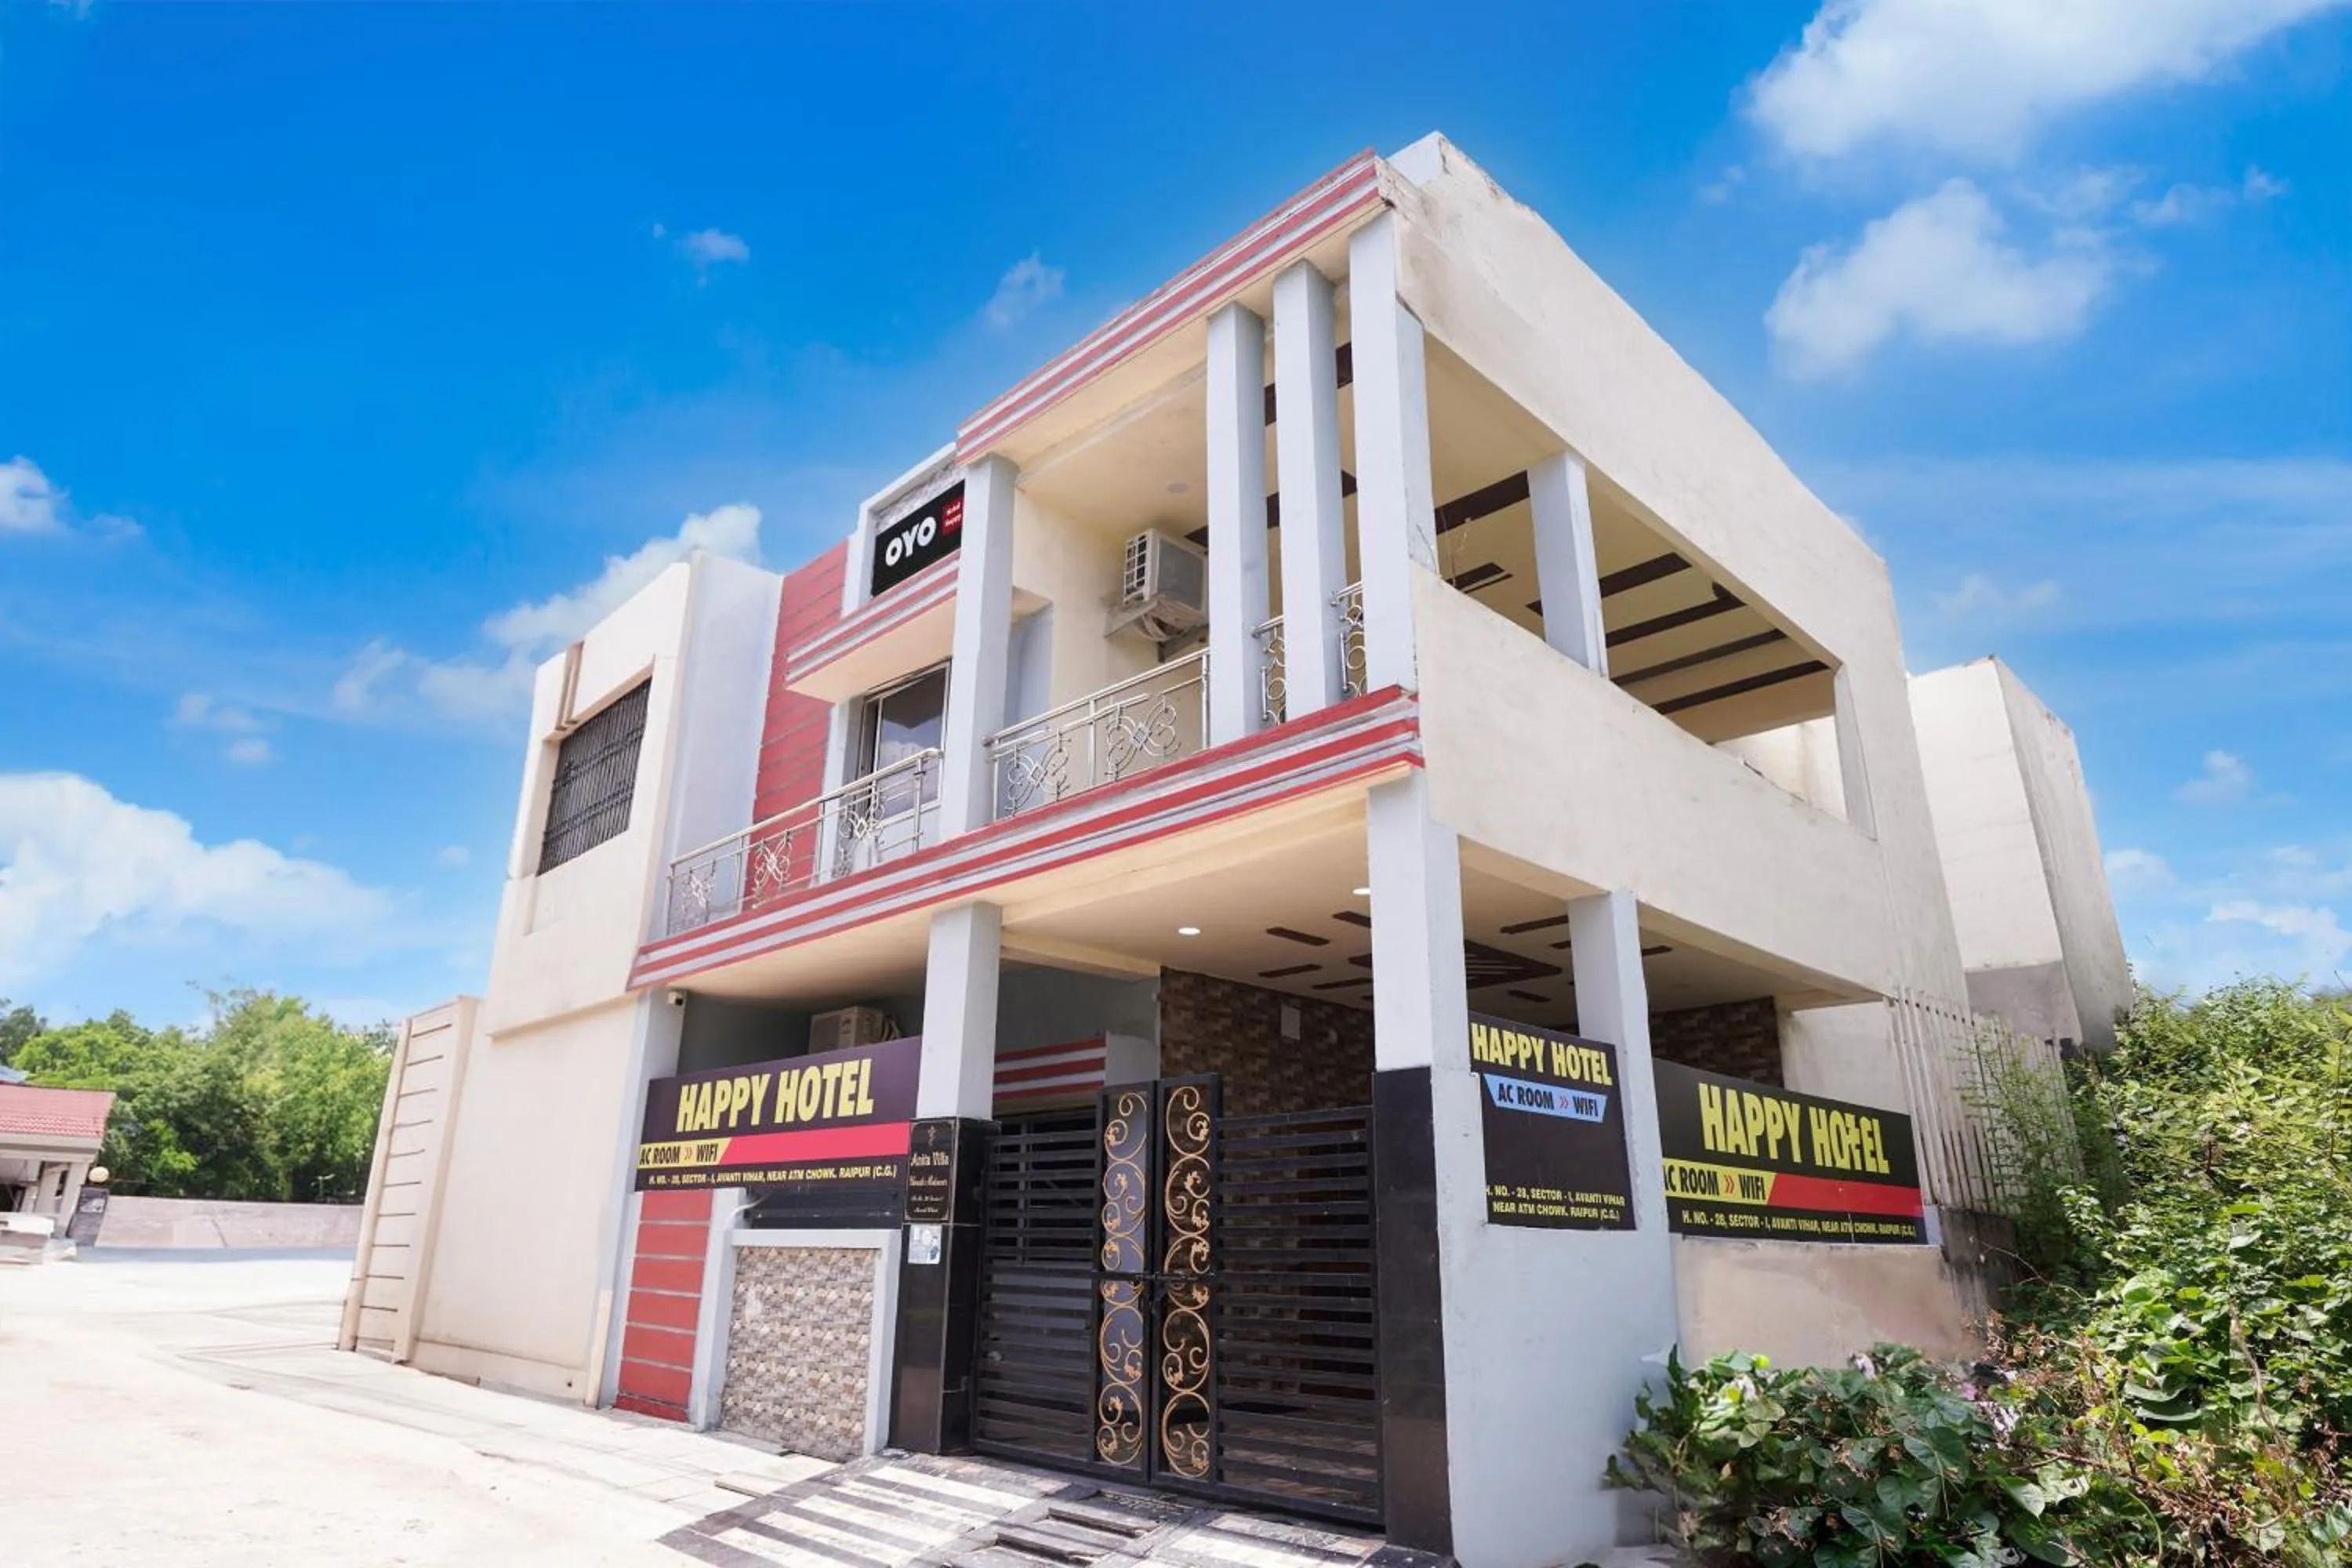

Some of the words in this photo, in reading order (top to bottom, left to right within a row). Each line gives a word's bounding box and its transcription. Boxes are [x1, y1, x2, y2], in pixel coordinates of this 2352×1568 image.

[885, 517, 937, 567] OYO
[1471, 1022, 1545, 1073] HAPPY
[1550, 1040, 1613, 1086] HOTEL
[676, 1074, 771, 1133] HAPPY
[774, 1058, 874, 1123] HOTEL
[1498, 1083, 1514, 1103] AC
[1517, 1086, 1555, 1110] ROOM
[1573, 1095, 1599, 1117] WIFI
[1698, 1083, 1802, 1163] HAPPY
[1809, 1105, 1889, 1174] HOTEL
[640, 1148, 652, 1165] AC
[653, 1146, 681, 1164] ROOM
[697, 1143, 719, 1162] WIFI
[766, 1171, 786, 1181] NEAR
[788, 1170, 804, 1180] ATM
[839, 1166, 870, 1178] RAIPUR
[1679, 1167, 1719, 1196] ROOM
[1739, 1174, 1766, 1200] WIFI
[1493, 1201, 1516, 1214] NEAR
[1518, 1203, 1535, 1214] ATM
[1570, 1207, 1599, 1218] RAIPUR
[1494, 1185, 1510, 1196] NO.
[1530, 1188, 1563, 1200] SECTOR
[1575, 1192, 1602, 1203] AVANTI
[1693, 1210, 1709, 1225] NO.
[1729, 1214, 1760, 1228] SECTOR
